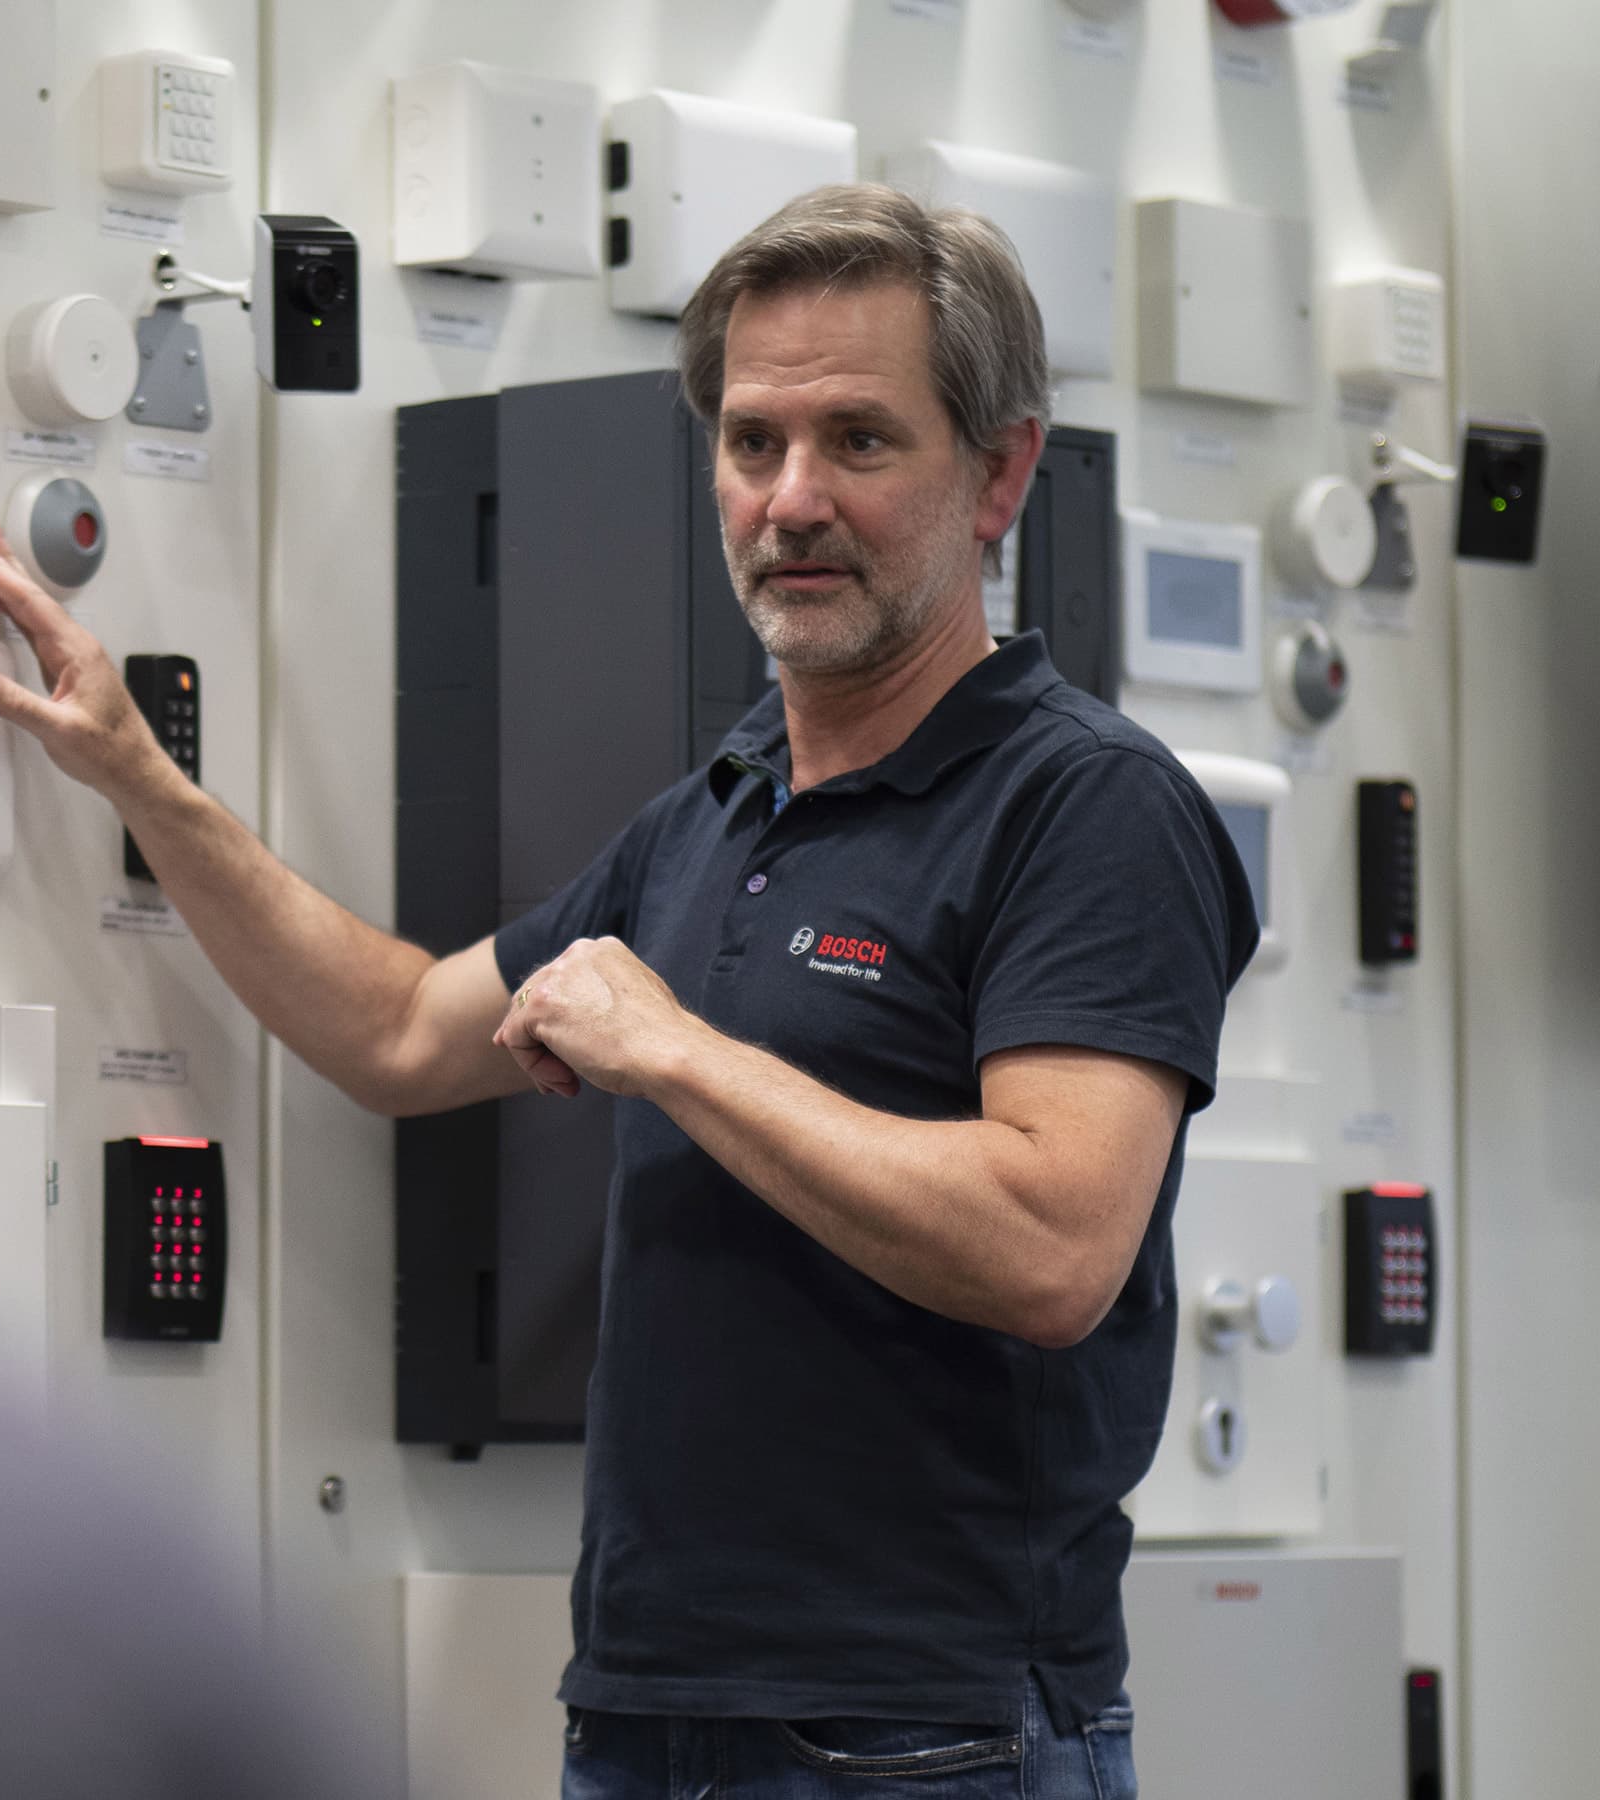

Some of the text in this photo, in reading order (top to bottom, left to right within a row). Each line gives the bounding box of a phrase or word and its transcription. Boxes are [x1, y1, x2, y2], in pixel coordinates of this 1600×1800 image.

[817, 934, 887, 965] BOSCH
[808, 958, 882, 981] Invented for life
